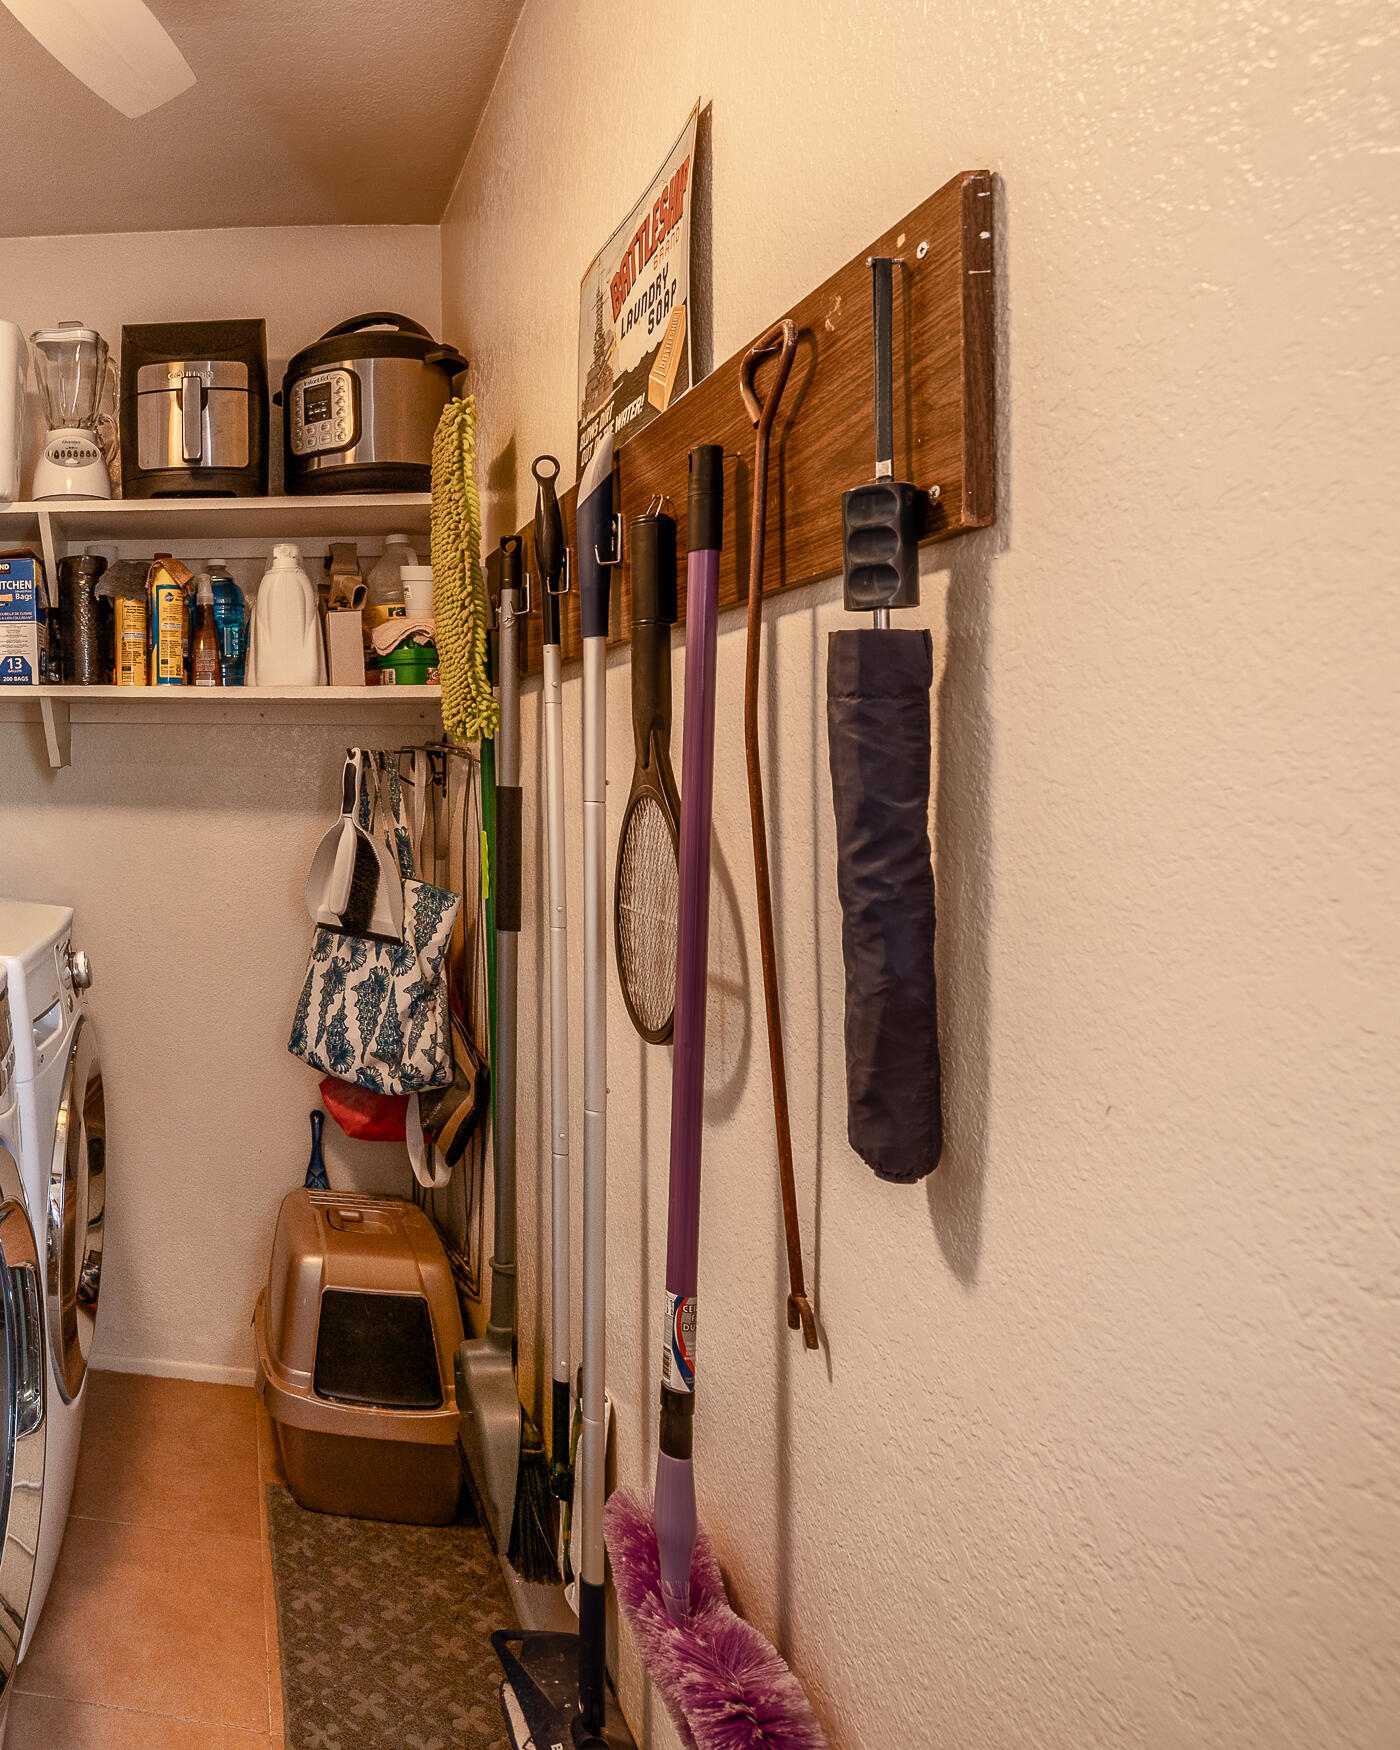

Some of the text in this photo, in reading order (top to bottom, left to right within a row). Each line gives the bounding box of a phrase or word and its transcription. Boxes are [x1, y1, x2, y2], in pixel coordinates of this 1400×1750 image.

[610, 154, 691, 323] BATTLESHIP
[653, 226, 681, 271] BRAND
[620, 262, 669, 340] LAUNDRY
[647, 278, 677, 336] SOAP
[598, 400, 614, 433] DIRT
[615, 391, 645, 434] WATER!
[15, 593, 33, 601] Bags
[7, 657, 23, 669] 13
